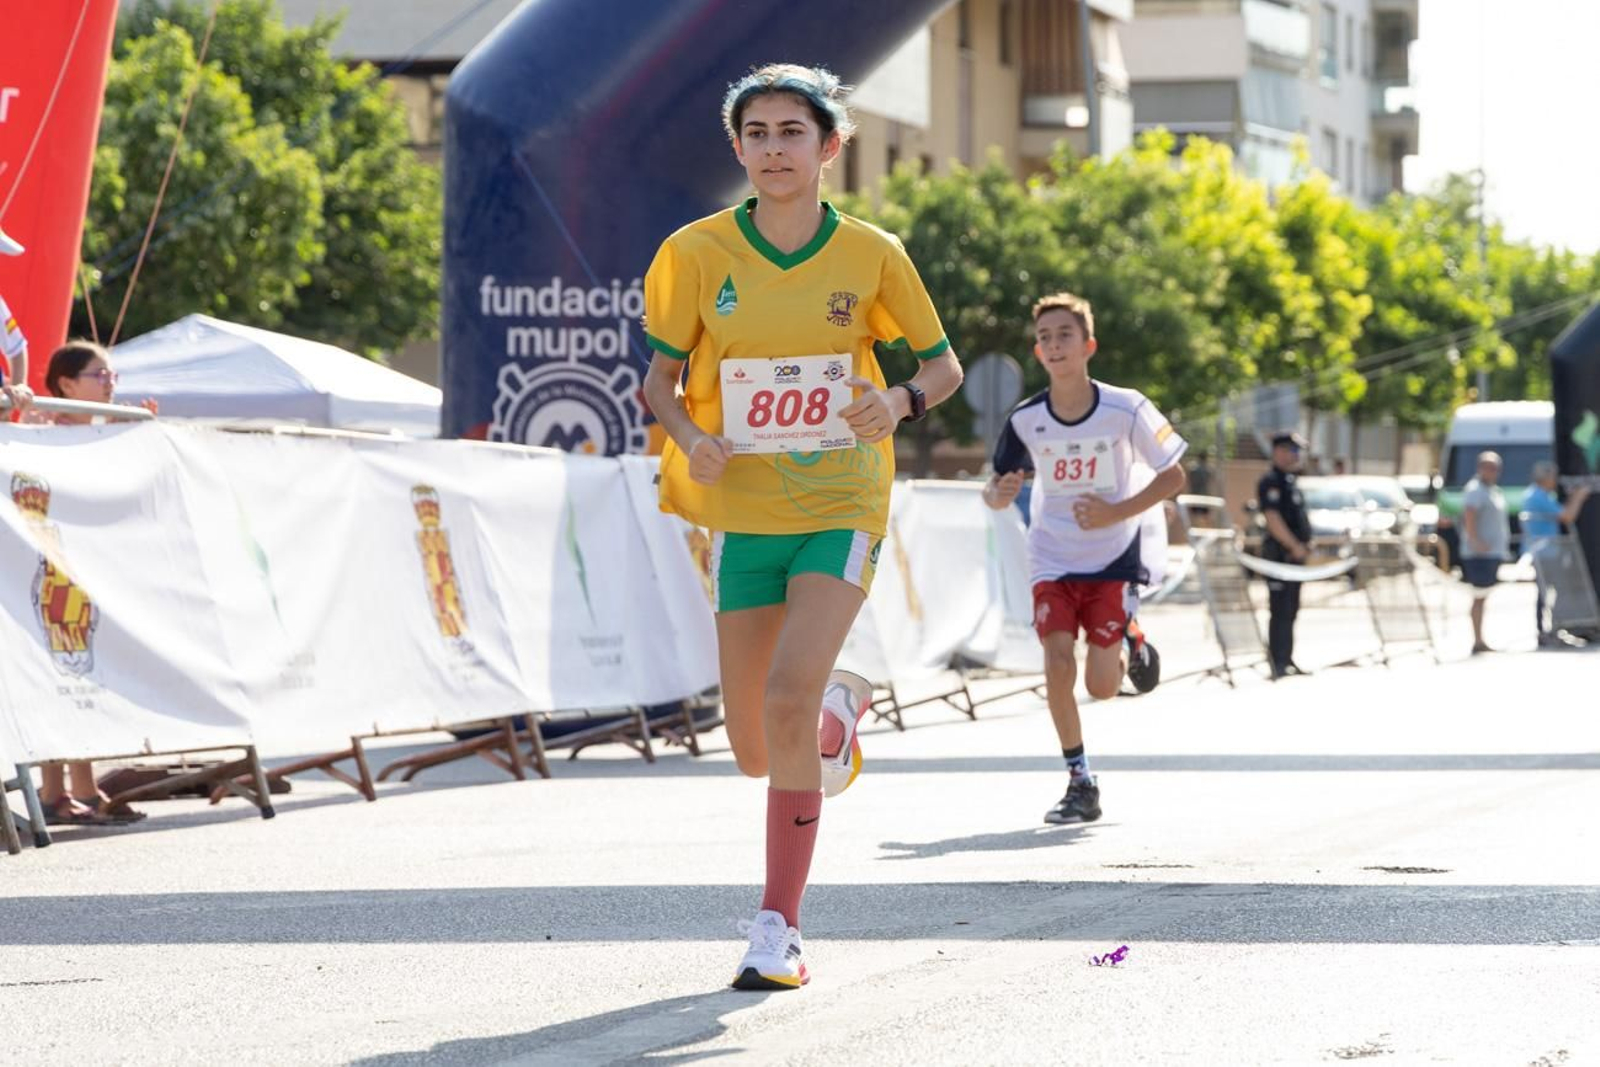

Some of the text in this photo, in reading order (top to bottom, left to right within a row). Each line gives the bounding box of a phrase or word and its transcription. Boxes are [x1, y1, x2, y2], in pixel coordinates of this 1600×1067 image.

[480, 275, 645, 317] fundació
[507, 319, 628, 364] mupol
[747, 387, 830, 428] 808
[1053, 456, 1097, 481] 831
